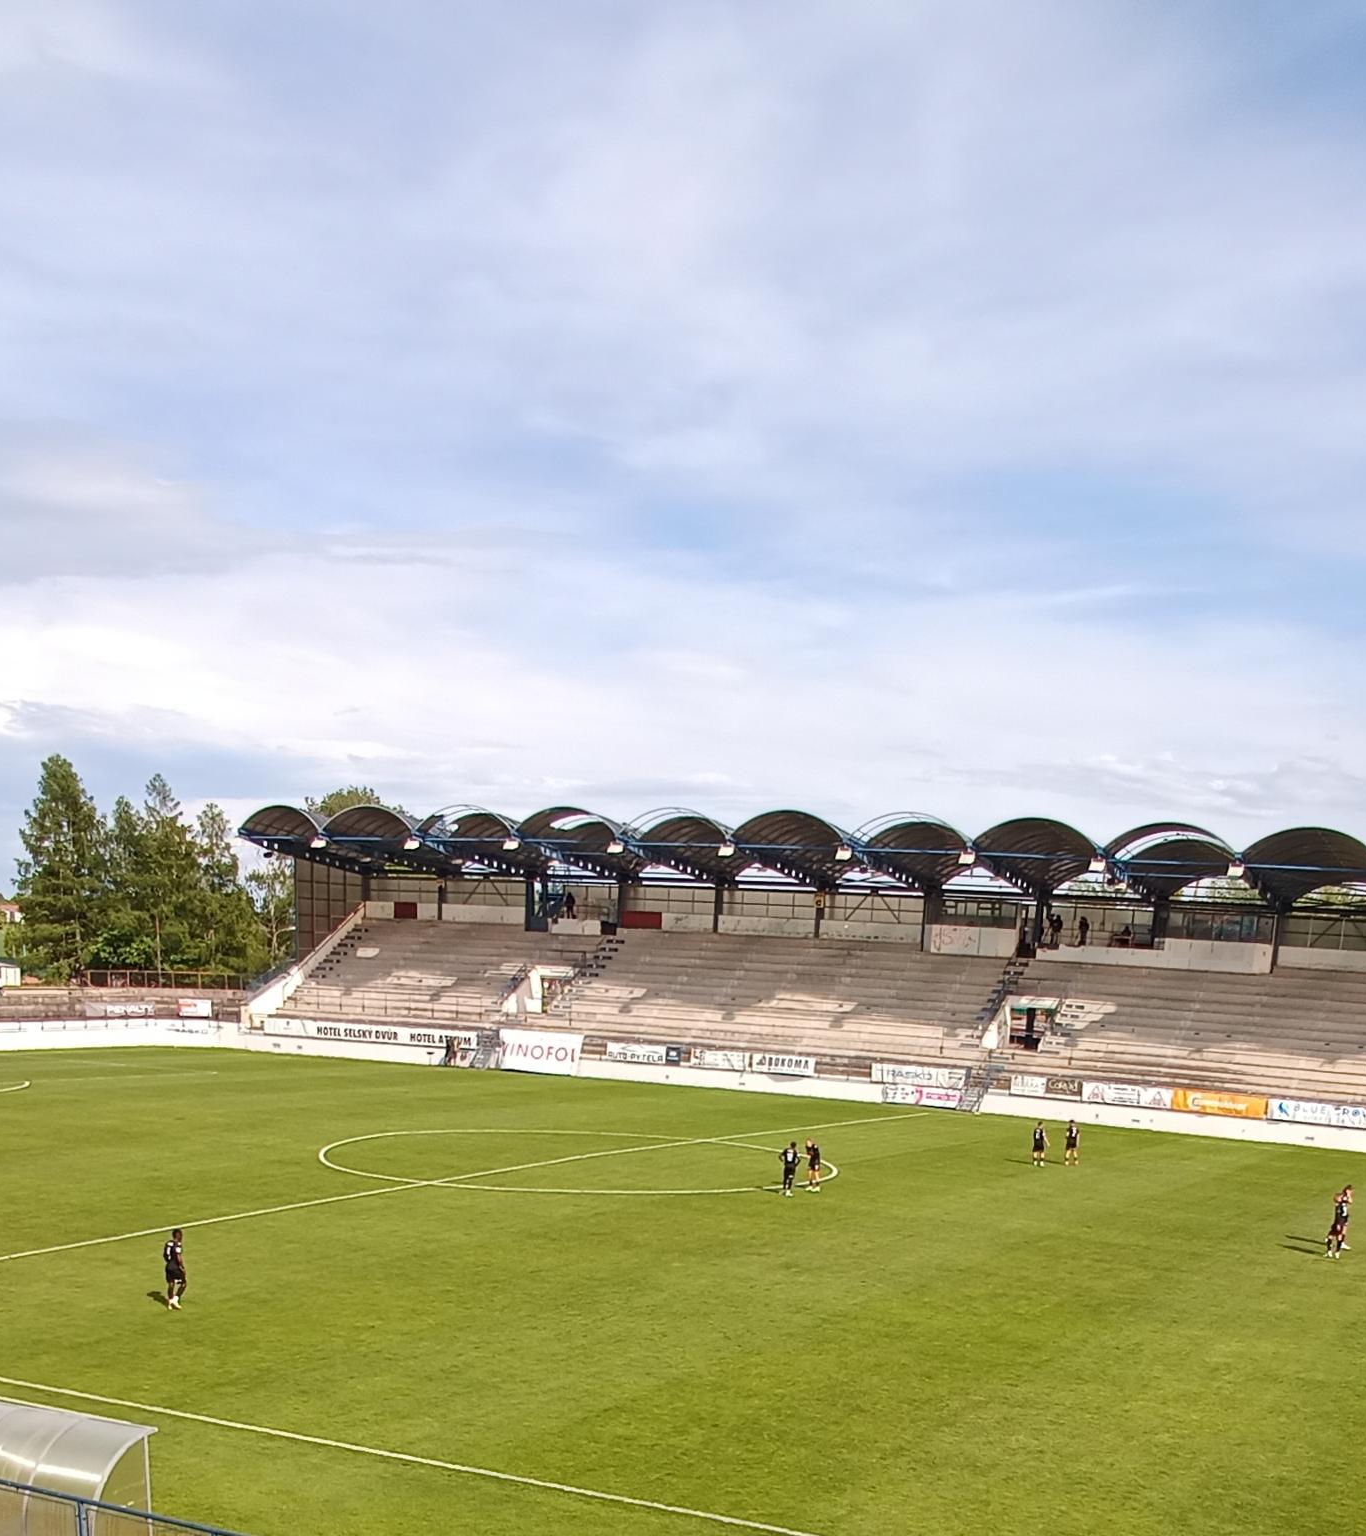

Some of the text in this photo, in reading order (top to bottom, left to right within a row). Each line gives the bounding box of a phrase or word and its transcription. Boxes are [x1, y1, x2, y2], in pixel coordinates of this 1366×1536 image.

[107, 1004, 155, 1017] PENALTY
[316, 1026, 342, 1038] HOTEL
[343, 1027, 373, 1040] SELSKÝ
[409, 1032, 436, 1045] HOTEL
[767, 1056, 810, 1070] BOKOMA
